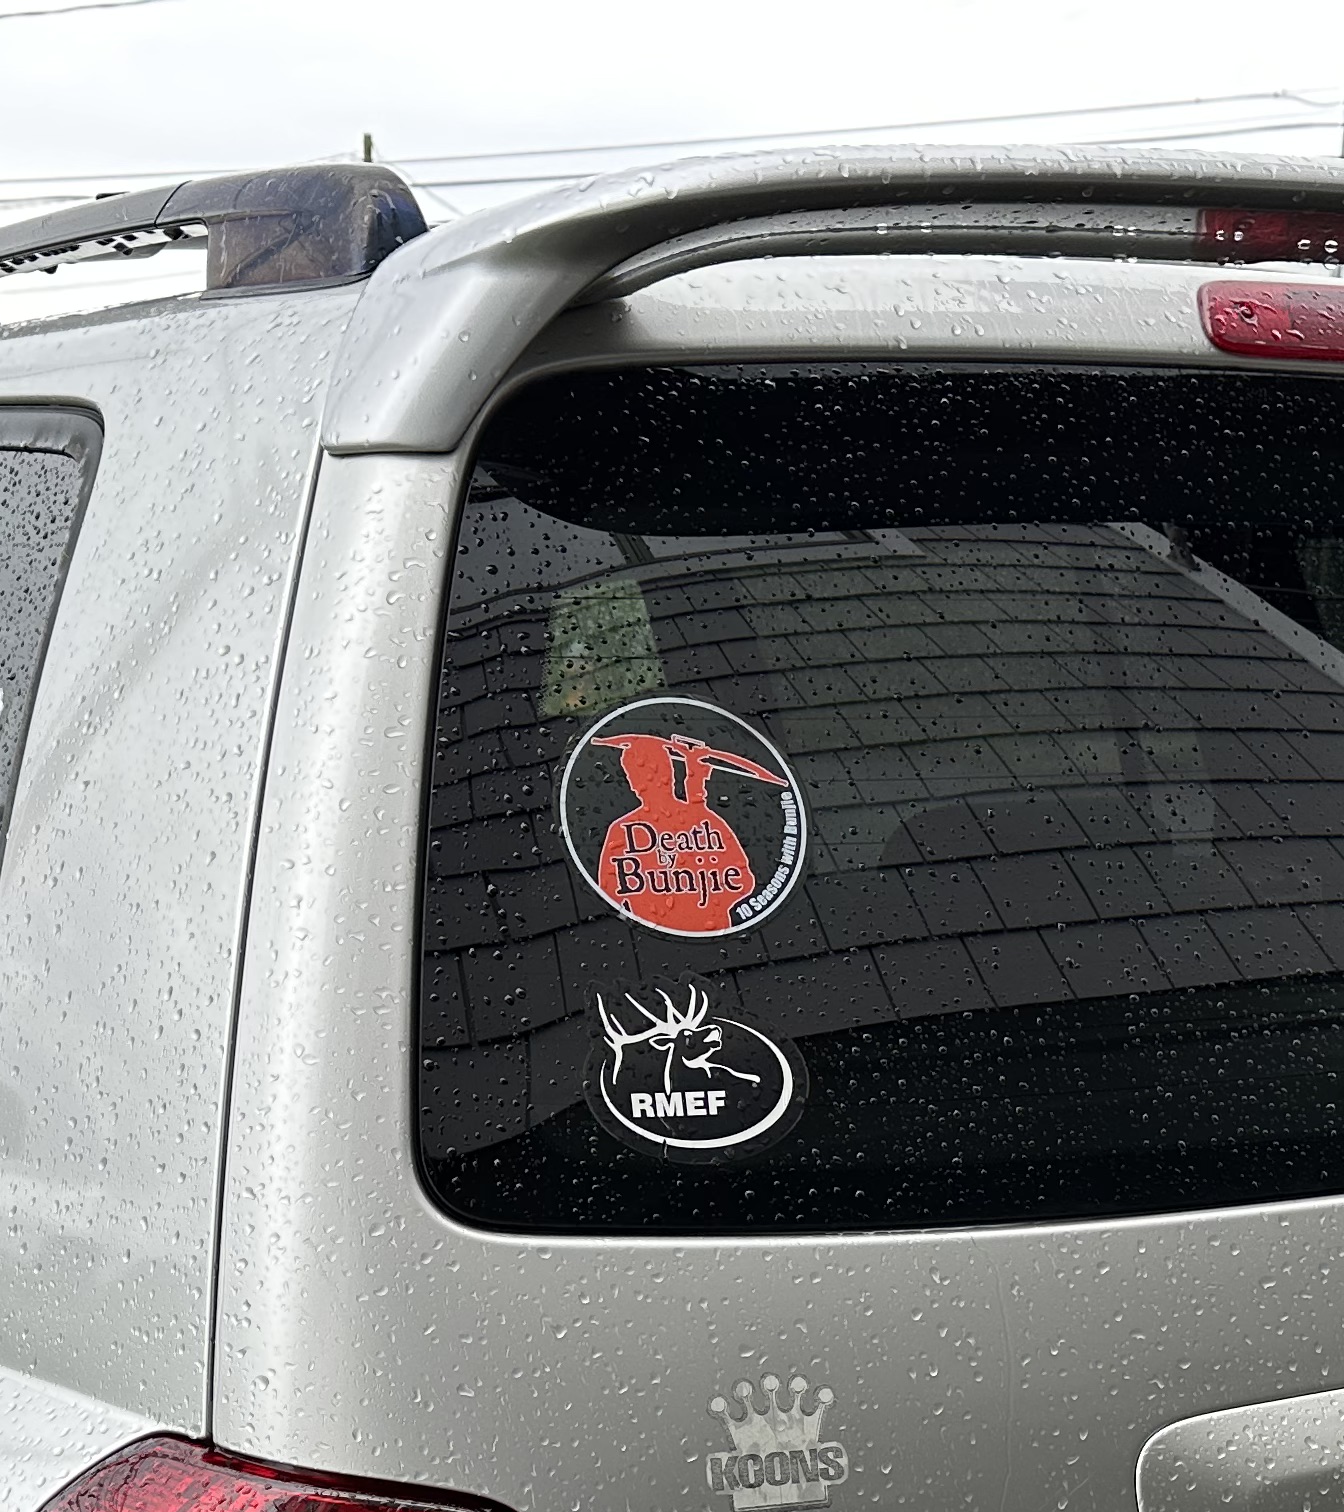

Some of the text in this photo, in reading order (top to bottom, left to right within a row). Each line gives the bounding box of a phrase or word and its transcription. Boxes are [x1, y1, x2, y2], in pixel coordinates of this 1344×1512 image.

[621, 820, 725, 855] Death
[658, 849, 678, 868] by
[735, 791, 798, 921] 10 Seasons with Bunjie
[611, 855, 745, 907] Bunjie
[630, 1090, 726, 1118] RMEF
